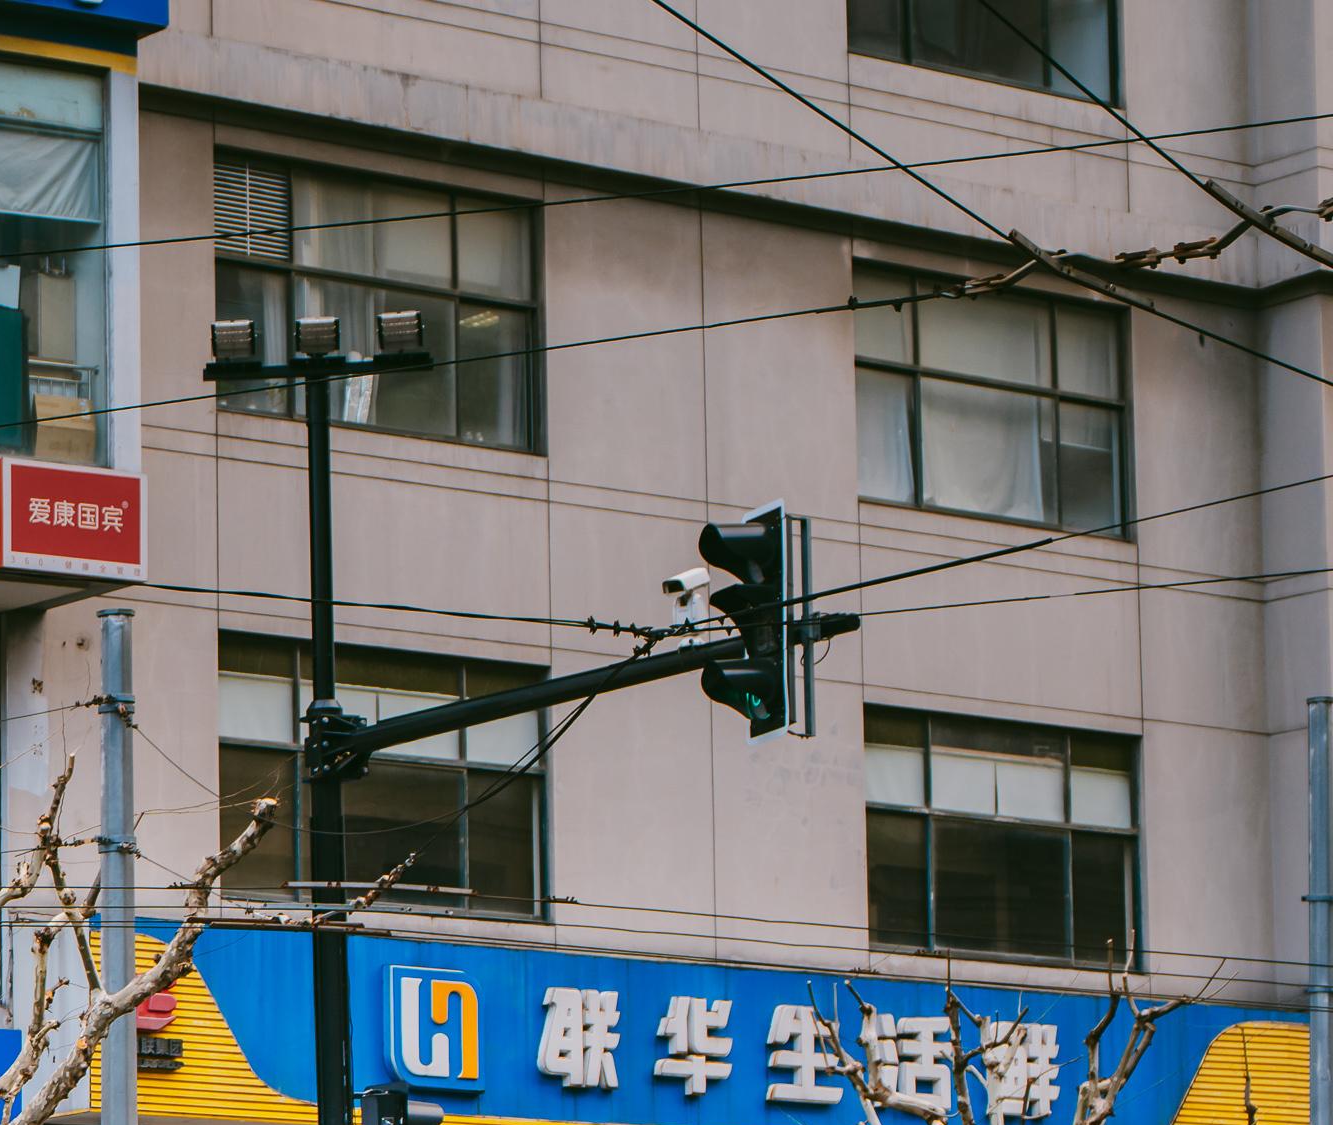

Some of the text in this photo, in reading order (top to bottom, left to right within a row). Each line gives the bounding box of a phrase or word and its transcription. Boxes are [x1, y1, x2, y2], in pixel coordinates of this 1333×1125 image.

[536, 986, 1060, 1118] 联华生活鲜
